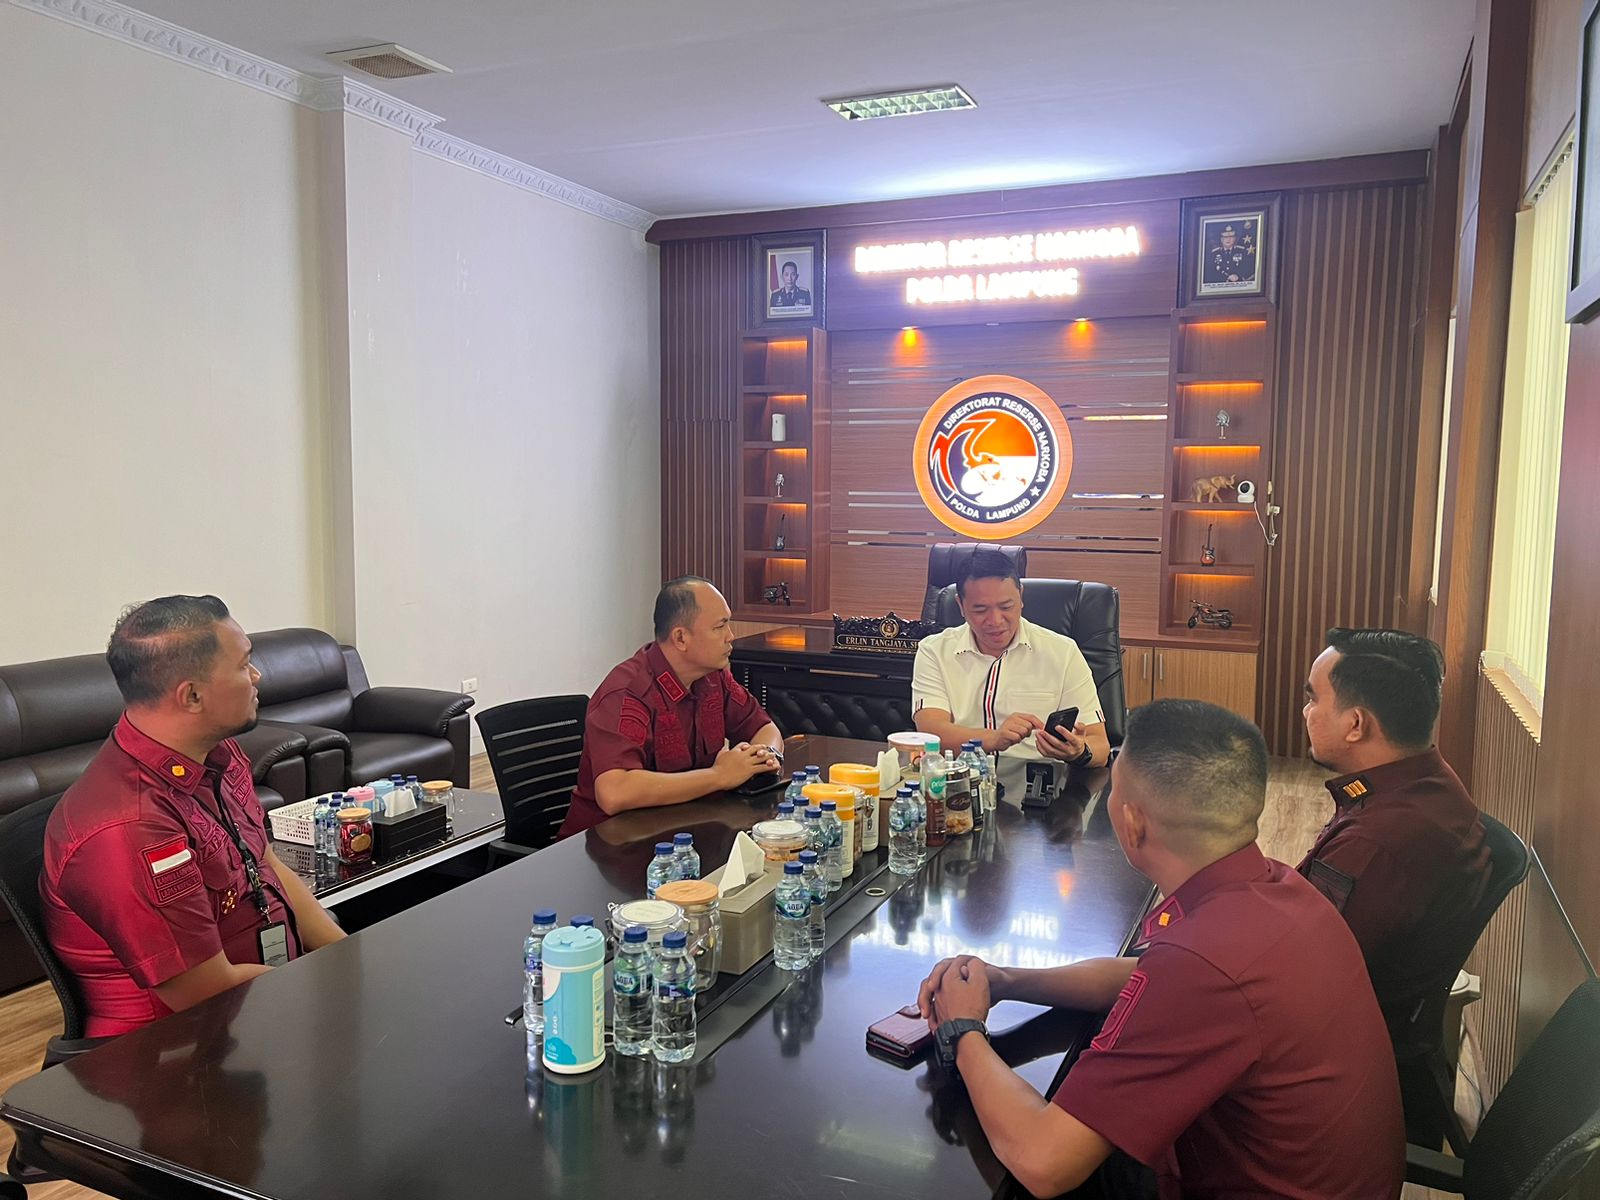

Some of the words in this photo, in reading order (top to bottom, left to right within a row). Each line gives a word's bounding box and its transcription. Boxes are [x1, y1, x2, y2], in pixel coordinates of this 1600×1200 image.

[943, 396, 1002, 430] DIREKTORAT
[1002, 398, 1043, 432] RESERSE
[1036, 431, 1051, 483] NARKOBA
[950, 499, 980, 519] POLDA
[986, 498, 1031, 520] LAMPUNG
[845, 636, 868, 645] ERLIN
